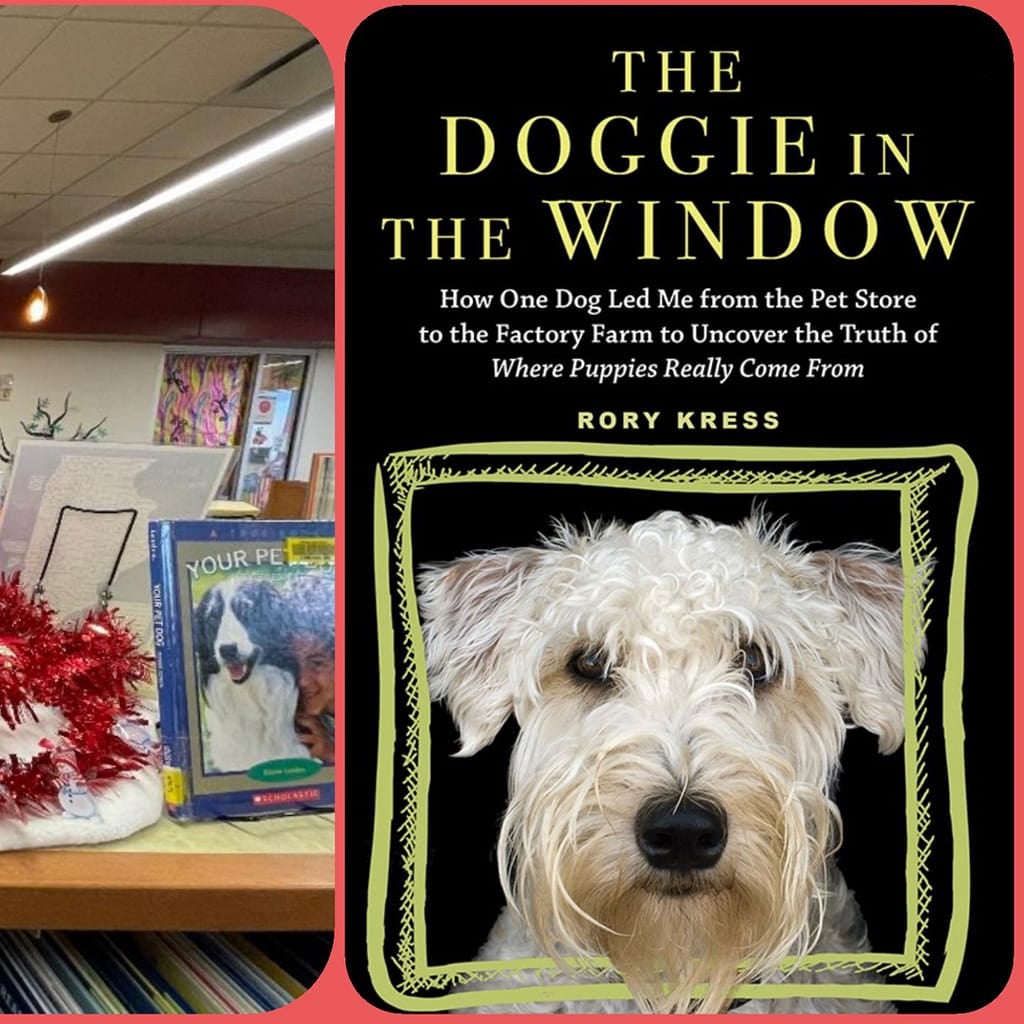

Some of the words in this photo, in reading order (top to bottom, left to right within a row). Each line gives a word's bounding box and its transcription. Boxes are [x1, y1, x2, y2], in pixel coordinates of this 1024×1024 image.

[612, 51, 741, 92] THE
[440, 116, 815, 175] DOGGIE
[850, 134, 913, 175] IN
[382, 218, 511, 259] THE
[542, 200, 975, 260] WINDOW
[441, 289, 493, 308] How
[500, 289, 547, 308] One
[556, 289, 601, 315] Dog
[609, 288, 650, 308] Led
[658, 289, 693, 308] Me
[700, 288, 758, 308] from
[765, 288, 803, 308] the
[811, 289, 848, 308] Pet
[856, 289, 916, 308] Store
[419, 327, 443, 343] to
[450, 322, 488, 343] the
[496, 324, 585, 349] Factory
[592, 324, 653, 343] Farm
[660, 327, 684, 343] to
[691, 324, 788, 343] Uncover
[795, 322, 833, 343] the
[840, 322, 907, 343] Truth
[914, 323, 939, 343] of
[492, 357, 563, 377] Where
[570, 358, 657, 383] Puppies
[664, 357, 733, 384] Really
[740, 358, 800, 377] Come
[806, 359, 864, 377] From
[578, 412, 660, 429] RORY
[678, 412, 778, 429] KRESS
[185, 549, 249, 579] YOUR
[256, 548, 287, 566] PE
[153, 584, 162, 608] YOUR
[154, 609, 163, 627] PET
[156, 627, 165, 648] DOG
[263, 789, 320, 802] SCHOLASTIC
